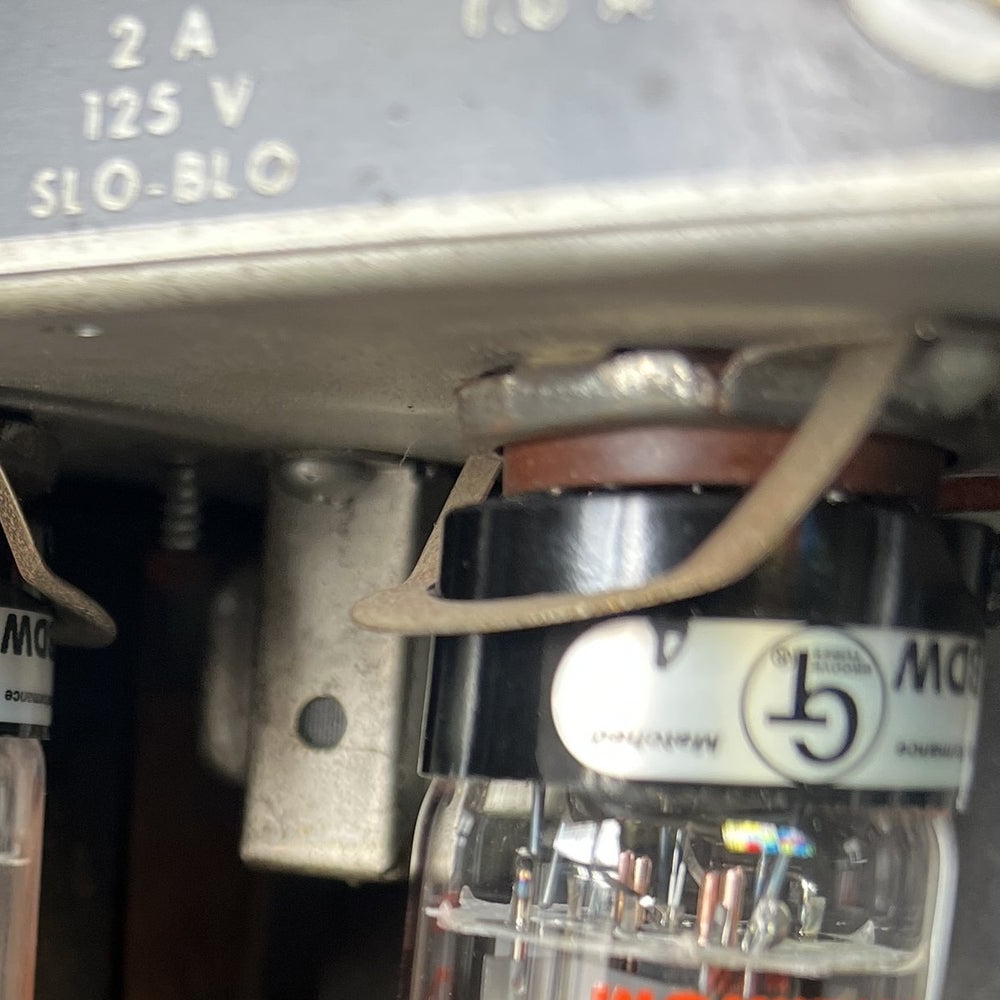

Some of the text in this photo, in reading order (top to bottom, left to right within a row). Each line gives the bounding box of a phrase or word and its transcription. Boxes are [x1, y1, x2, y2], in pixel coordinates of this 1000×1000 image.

[107, 6, 217, 69] 2 A
[82, 73, 254, 140] 125 V
[30, 139, 297, 219] SLO-BLO
